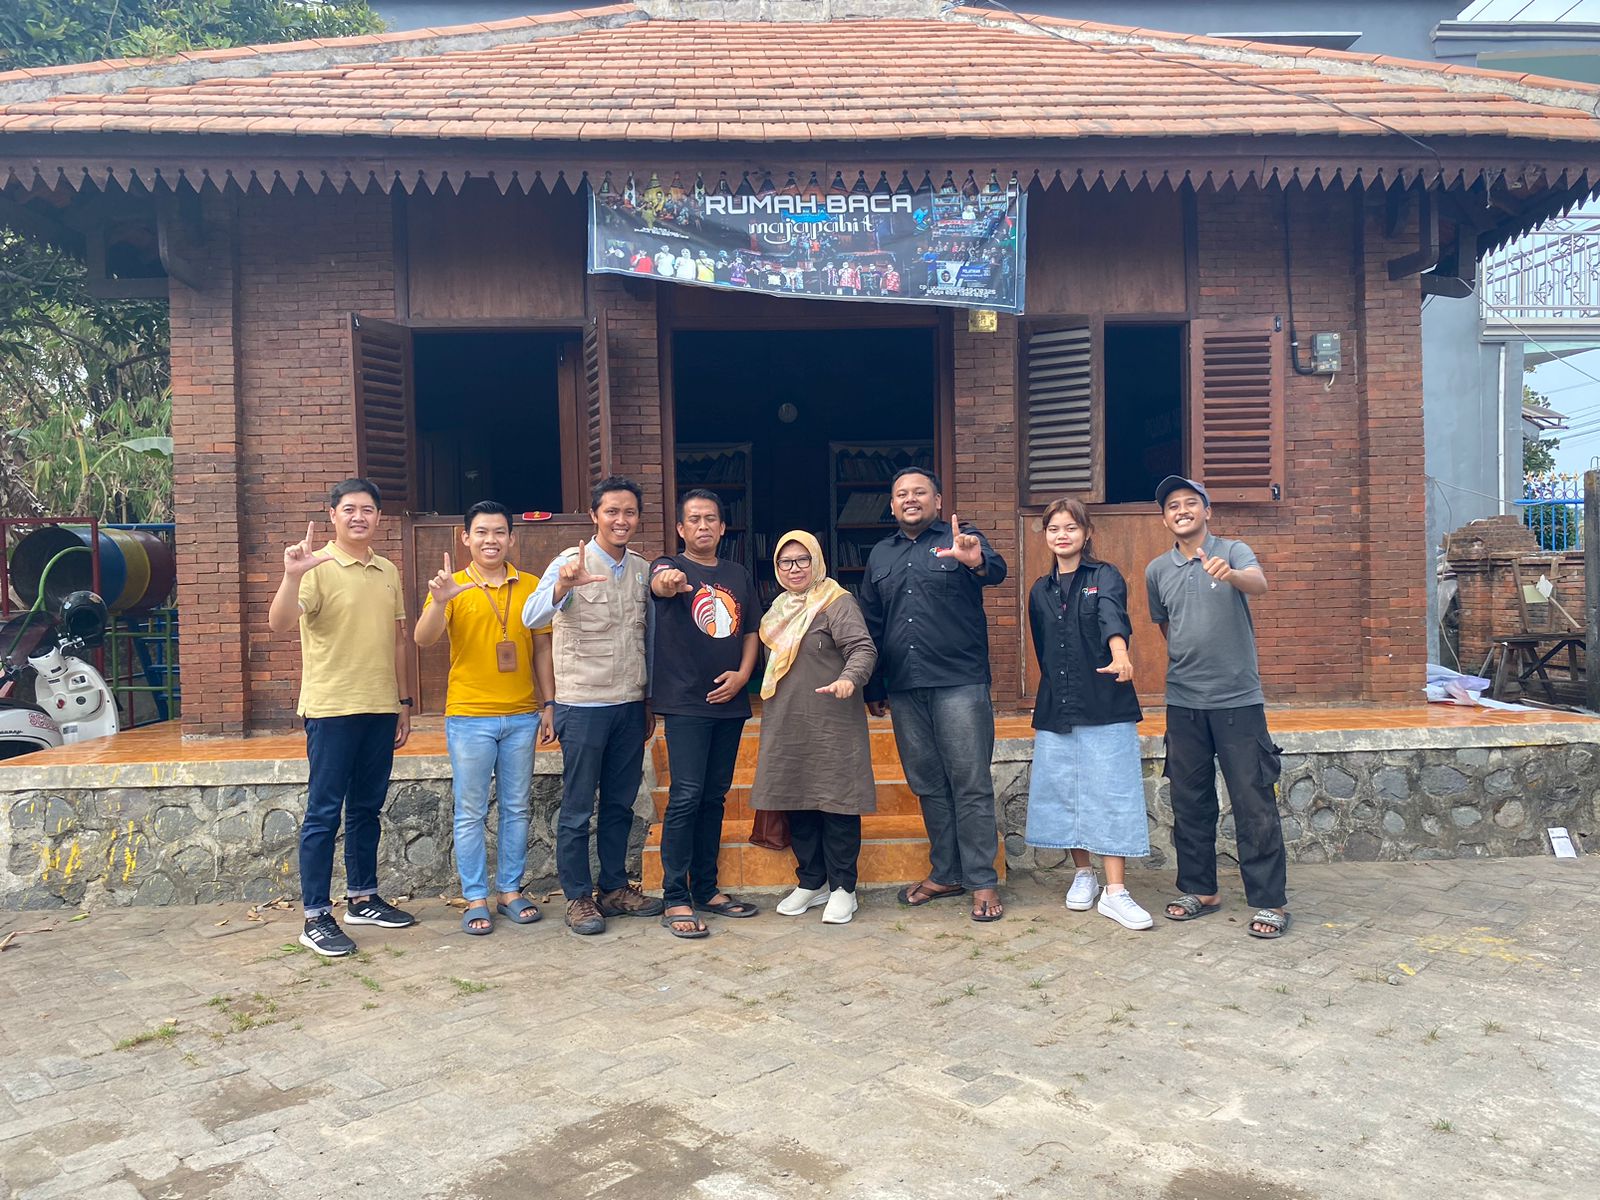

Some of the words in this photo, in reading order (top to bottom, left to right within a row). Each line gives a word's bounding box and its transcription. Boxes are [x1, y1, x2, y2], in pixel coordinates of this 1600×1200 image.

[705, 195, 812, 215] RUMAH
[826, 194, 912, 213] BACA
[748, 214, 876, 244] majapahit
